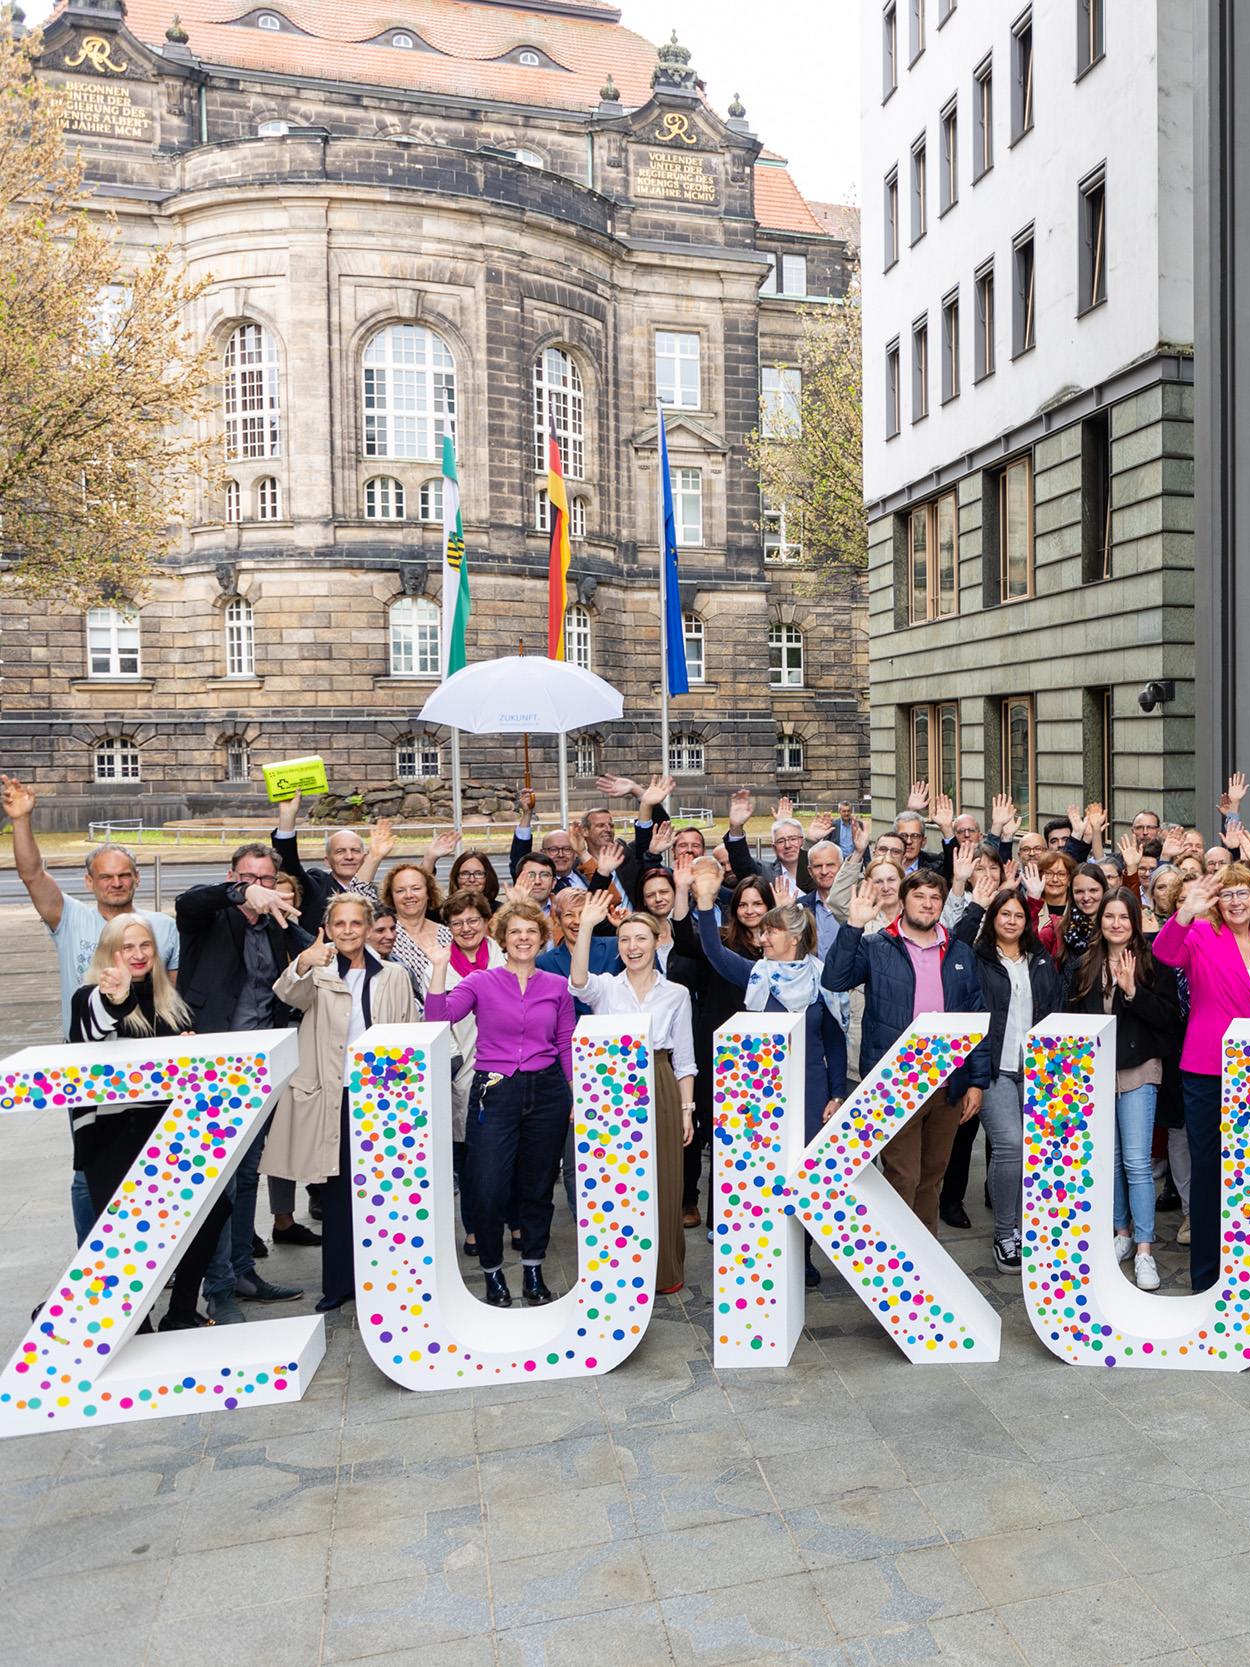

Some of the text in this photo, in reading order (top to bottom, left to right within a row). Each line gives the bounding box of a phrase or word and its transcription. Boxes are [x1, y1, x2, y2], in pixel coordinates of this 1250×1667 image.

[65, 81, 130, 97] BEGONNEN
[107, 95, 131, 107] DER
[122, 107, 146, 118] DES
[103, 114, 151, 128] ALBERT
[72, 120, 111, 133] JAHRE
[115, 125, 142, 137] MCM
[649, 152, 703, 166] VOLLENDET
[650, 162, 703, 174] UNTER DER
[638, 168, 714, 184] REGIERUNG DES
[637, 177, 715, 193] KOENIGS GEORG
[637, 186, 715, 201] IM JAHRE MCMIV
